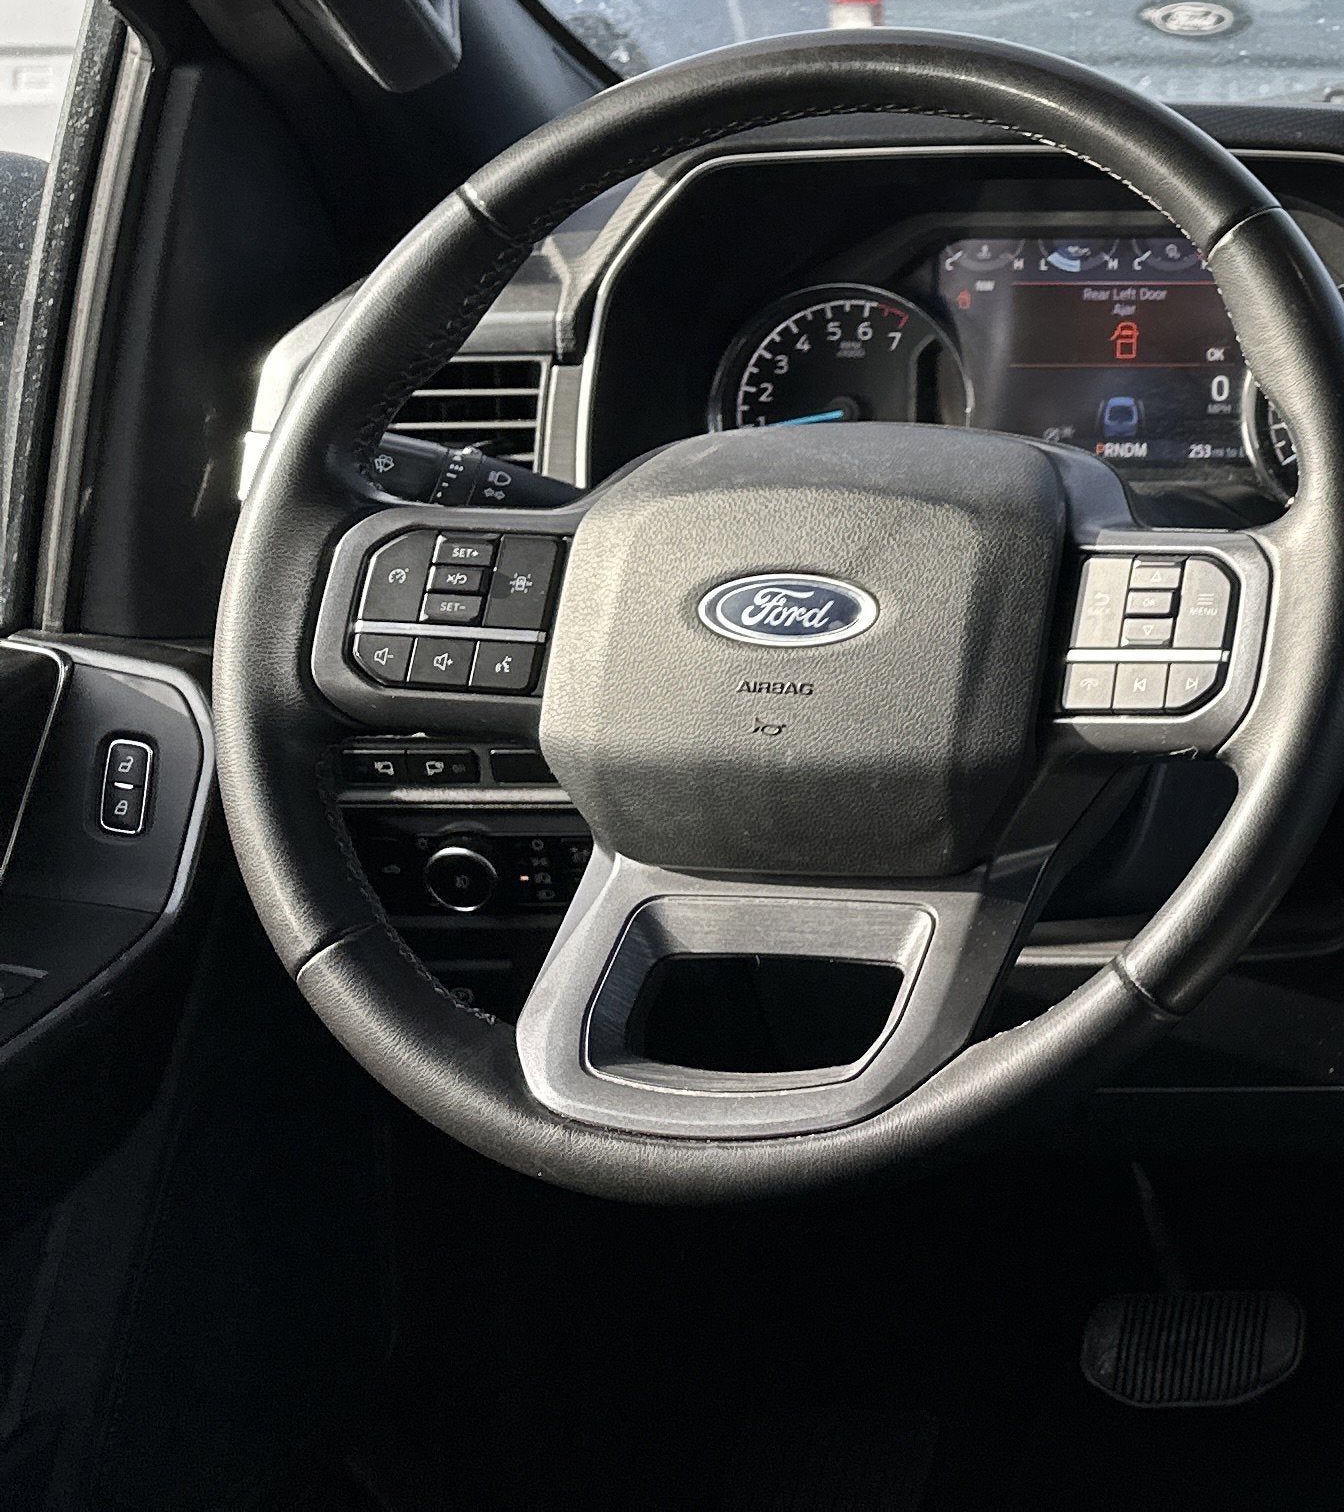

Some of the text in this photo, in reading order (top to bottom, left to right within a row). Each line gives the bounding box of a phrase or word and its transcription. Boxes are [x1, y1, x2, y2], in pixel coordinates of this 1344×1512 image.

[1083, 288, 1167, 300] Rear Left Door
[1112, 303, 1136, 316] Ajar
[826, 322, 841, 341] 5
[857, 322, 873, 341] 6
[795, 334, 811, 353] 4
[888, 332, 902, 352] 7
[1206, 348, 1225, 361] OK
[774, 355, 789, 375] 3
[759, 383, 773, 402] 2
[1211, 374, 1230, 402] 0
[1207, 404, 1232, 415] MPH
[1188, 444, 1212, 458] 253
[741, 587, 835, 629] Ford
[1189, 608, 1218, 616] MENU
[736, 680, 814, 696] AIRBAG
